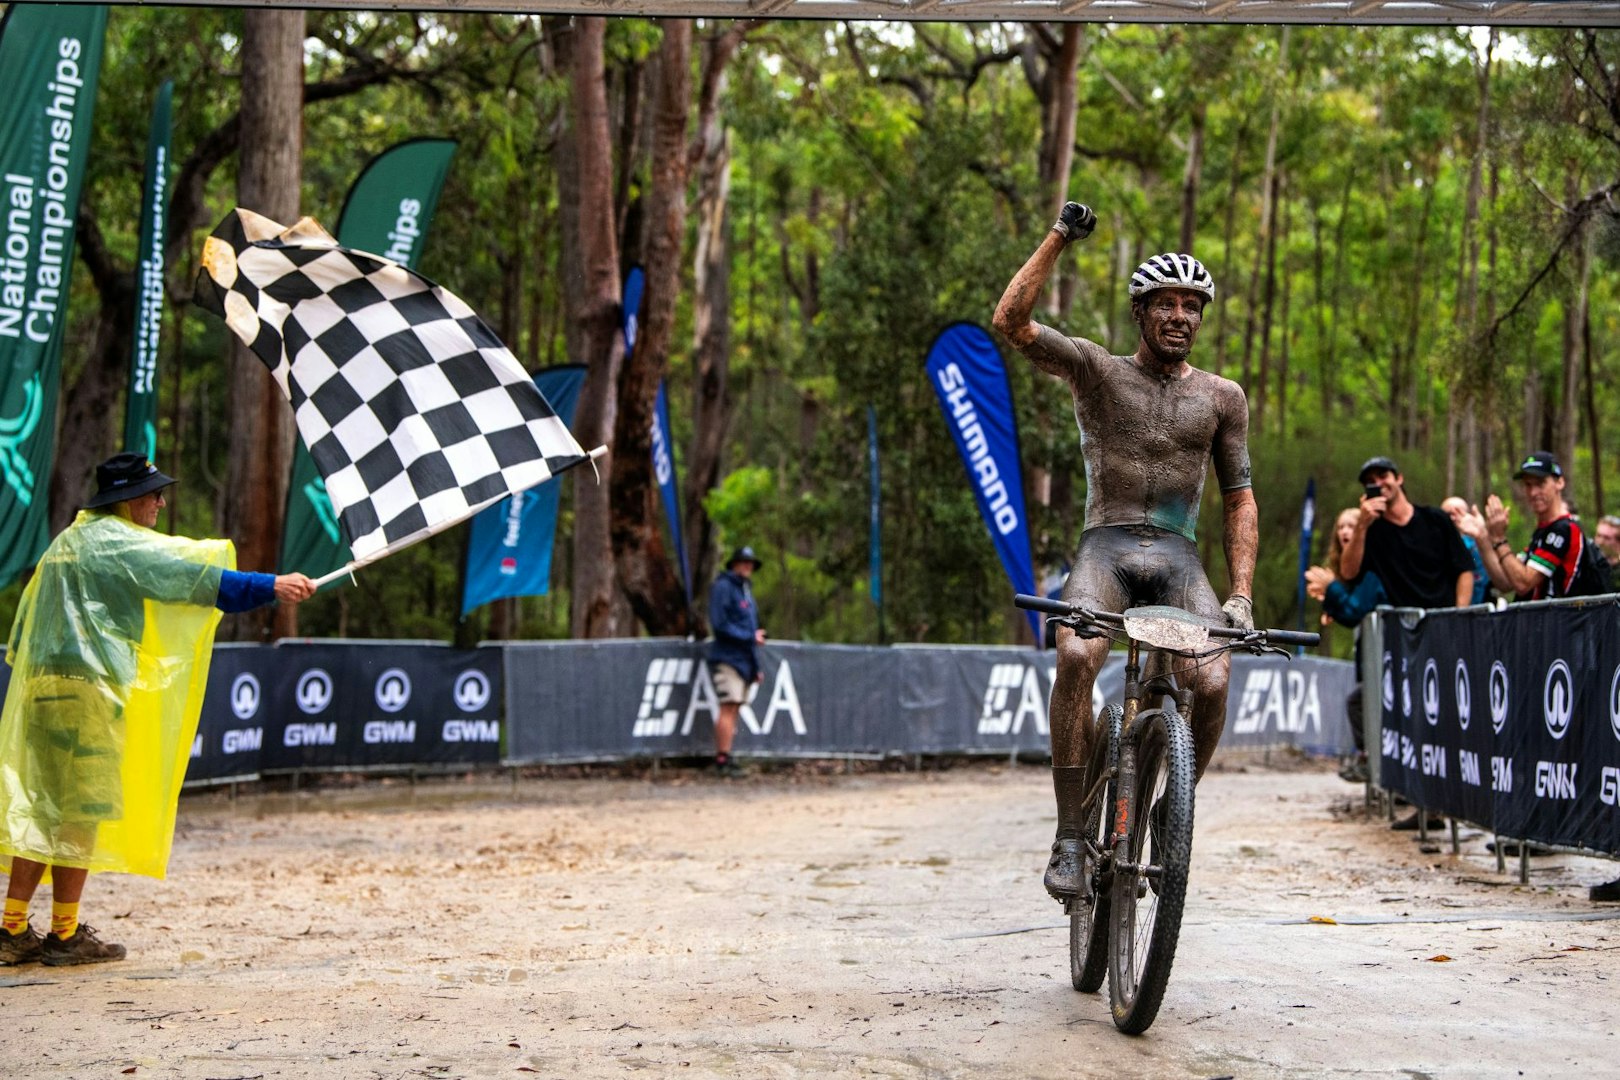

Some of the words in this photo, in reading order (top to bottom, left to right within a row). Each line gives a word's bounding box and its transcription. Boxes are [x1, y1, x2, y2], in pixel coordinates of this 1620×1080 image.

[24, 37, 83, 343] Championships
[0, 173, 34, 338] National
[938, 362, 1018, 536] SHIMANO
[1545, 532, 1564, 548] 98
[222, 727, 263, 754] GWM
[283, 722, 337, 747] GWM
[363, 720, 416, 743] GWM
[442, 719, 500, 742] GWM
